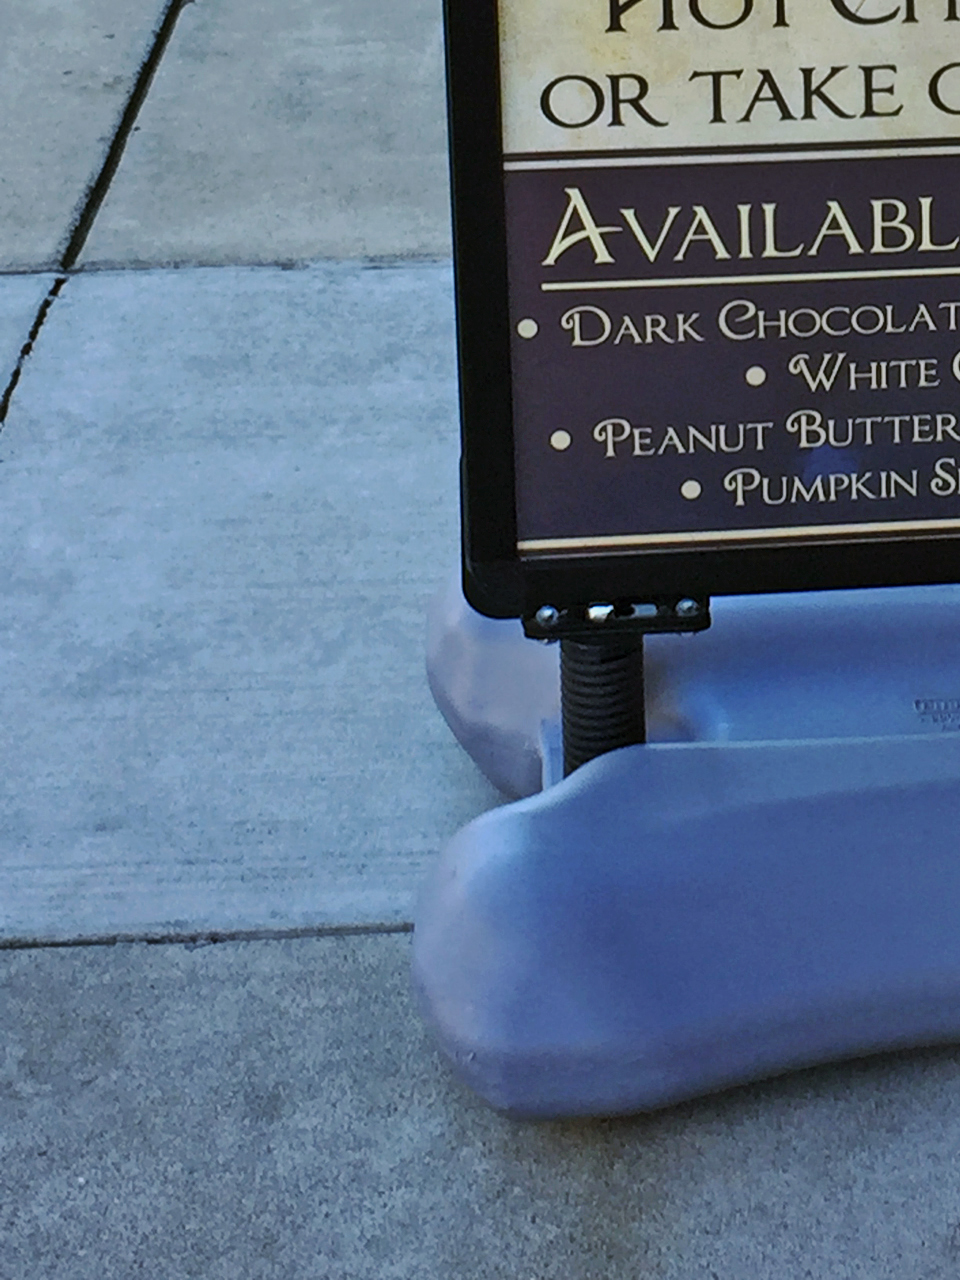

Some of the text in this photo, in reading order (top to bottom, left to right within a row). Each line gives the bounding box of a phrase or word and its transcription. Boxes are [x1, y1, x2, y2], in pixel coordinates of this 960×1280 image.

[540, 74, 668, 128] OR
[689, 65, 903, 123] TAKE
[561, 306, 703, 346] DARK
[789, 353, 940, 392] WHITE
[594, 419, 773, 456] PEANUT
[724, 467, 917, 505] PUMPKIN
